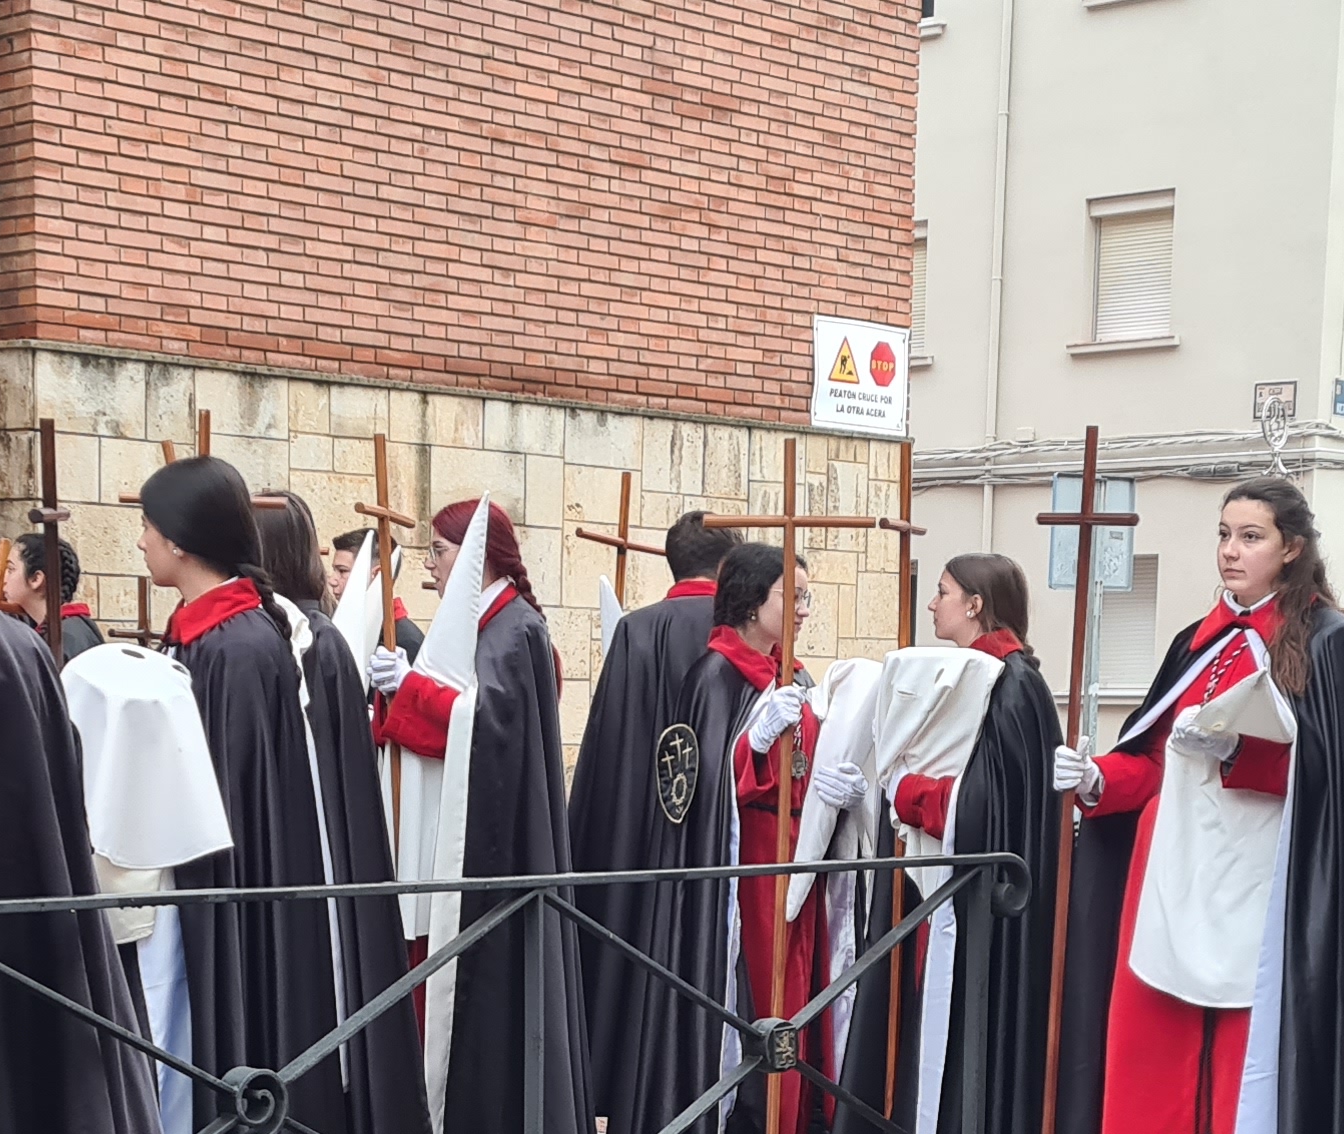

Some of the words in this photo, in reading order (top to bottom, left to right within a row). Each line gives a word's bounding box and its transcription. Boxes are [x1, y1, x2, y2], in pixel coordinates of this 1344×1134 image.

[871, 359, 894, 372] STOP
[858, 392, 878, 403] CRUCE
[880, 395, 892, 405] POR
[836, 404, 845, 413] LA
[847, 405, 864, 415] OTRA
[866, 408, 886, 418] ACERA
